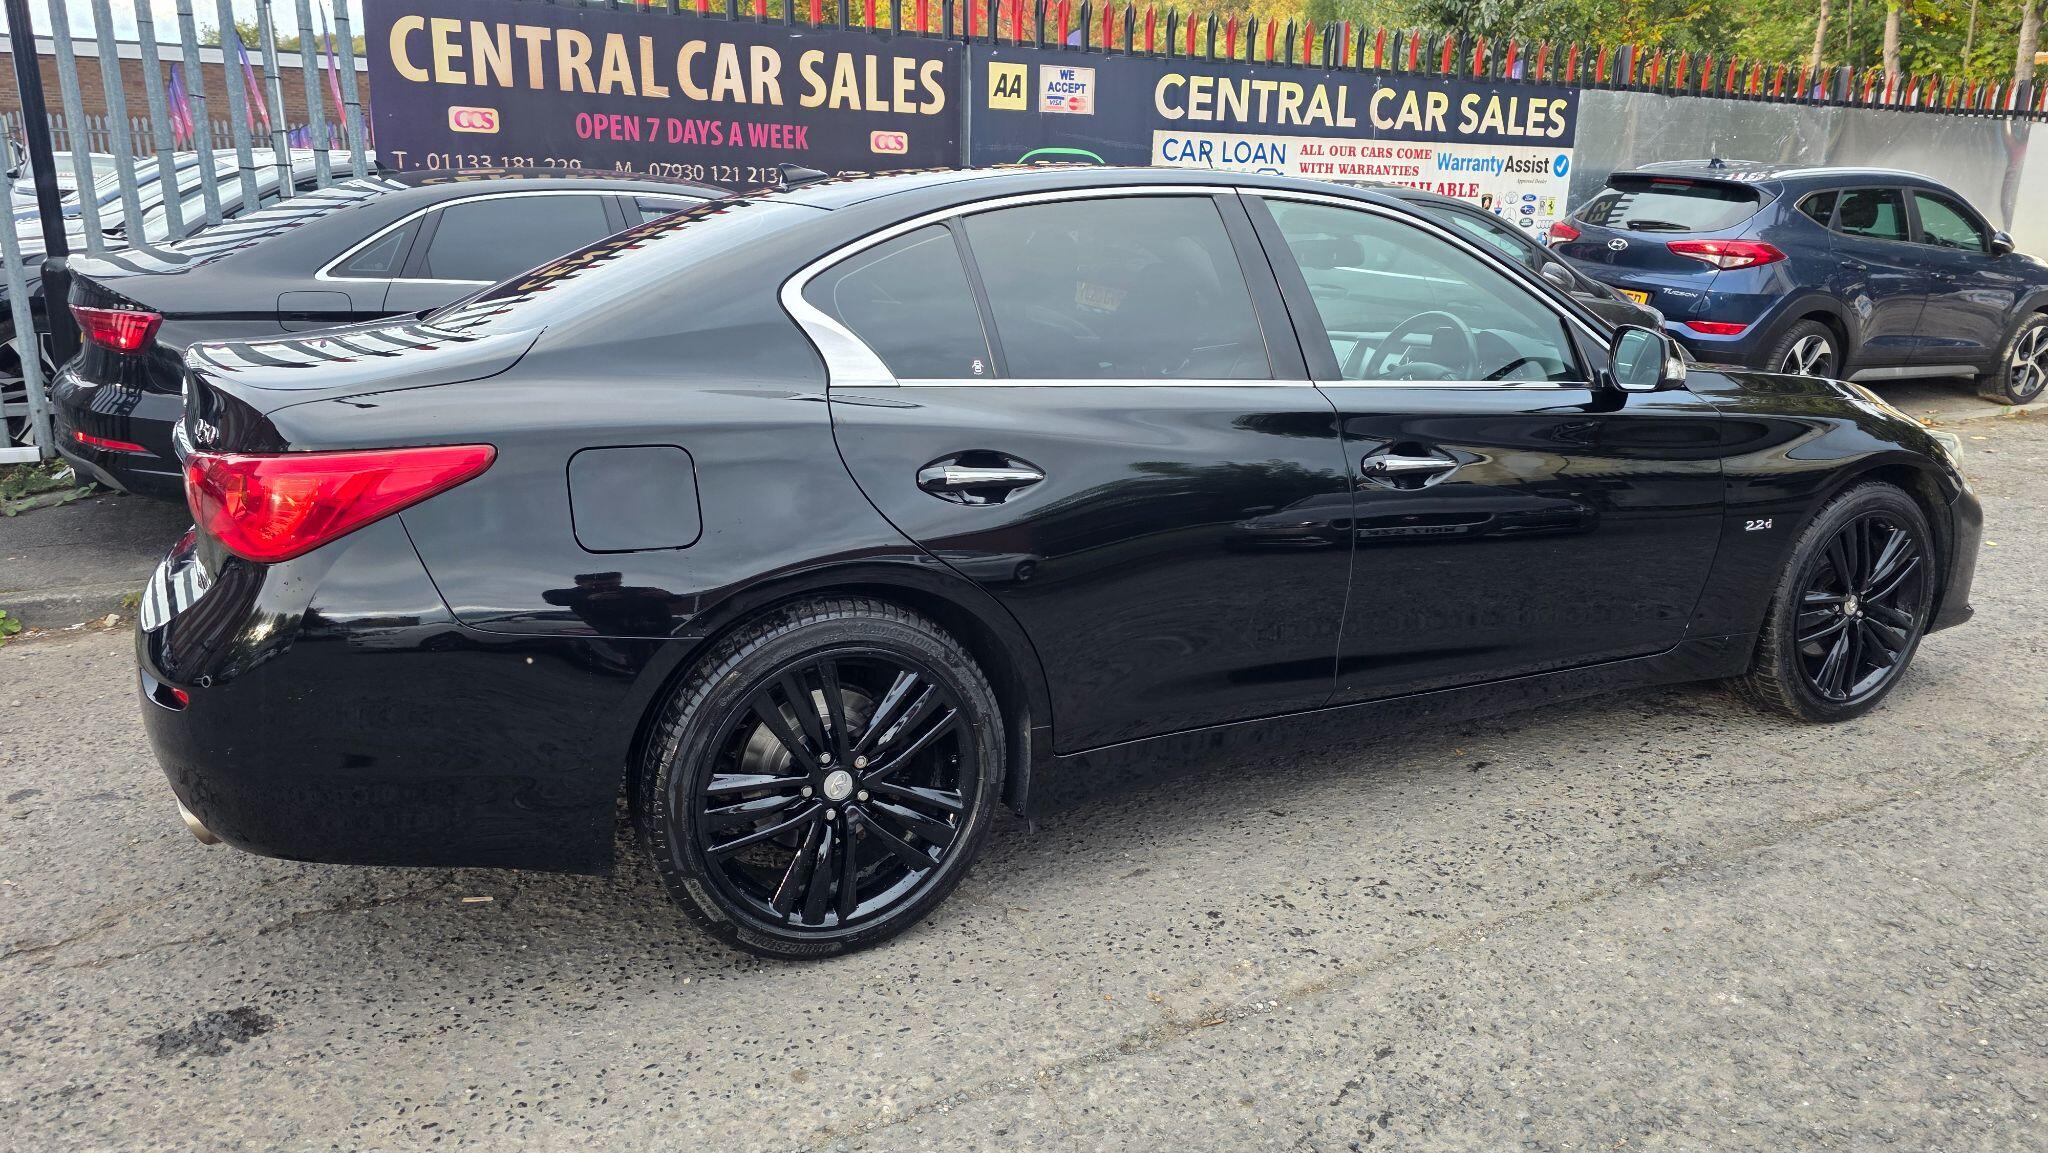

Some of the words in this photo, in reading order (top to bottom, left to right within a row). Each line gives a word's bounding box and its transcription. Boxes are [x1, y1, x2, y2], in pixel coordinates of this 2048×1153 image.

[390, 15, 671, 98] CENTRAL
[677, 40, 784, 106] CAR
[799, 49, 946, 115] SALES
[1060, 69, 1075, 80] WE
[993, 73, 1022, 98] AA
[1048, 82, 1087, 94] ACCEPT
[1154, 73, 1357, 128] CENTRAL
[1369, 87, 1449, 132] CAR
[1457, 93, 1568, 138] SALES
[575, 112, 641, 142] OPEN
[646, 117, 661, 143] 7
[667, 117, 724, 145] DAYS
[729, 120, 744, 147] A
[748, 122, 810, 150] WEEK
[1162, 138, 1213, 162] CAR
[1222, 140, 1287, 164] LOAN
[1300, 144, 1325, 156] ALL
[1329, 145, 1357, 157] OUR
[1361, 147, 1393, 158] CARS
[1397, 148, 1432, 159] COME
[649, 162, 705, 181] 07930
[711, 166, 740, 182] 121
[747, 167, 779, 184] 213
[1300, 162, 1334, 174] WITH
[1338, 163, 1420, 176] WARRANTIES
[1663, 287, 1699, 298] TUCSON
